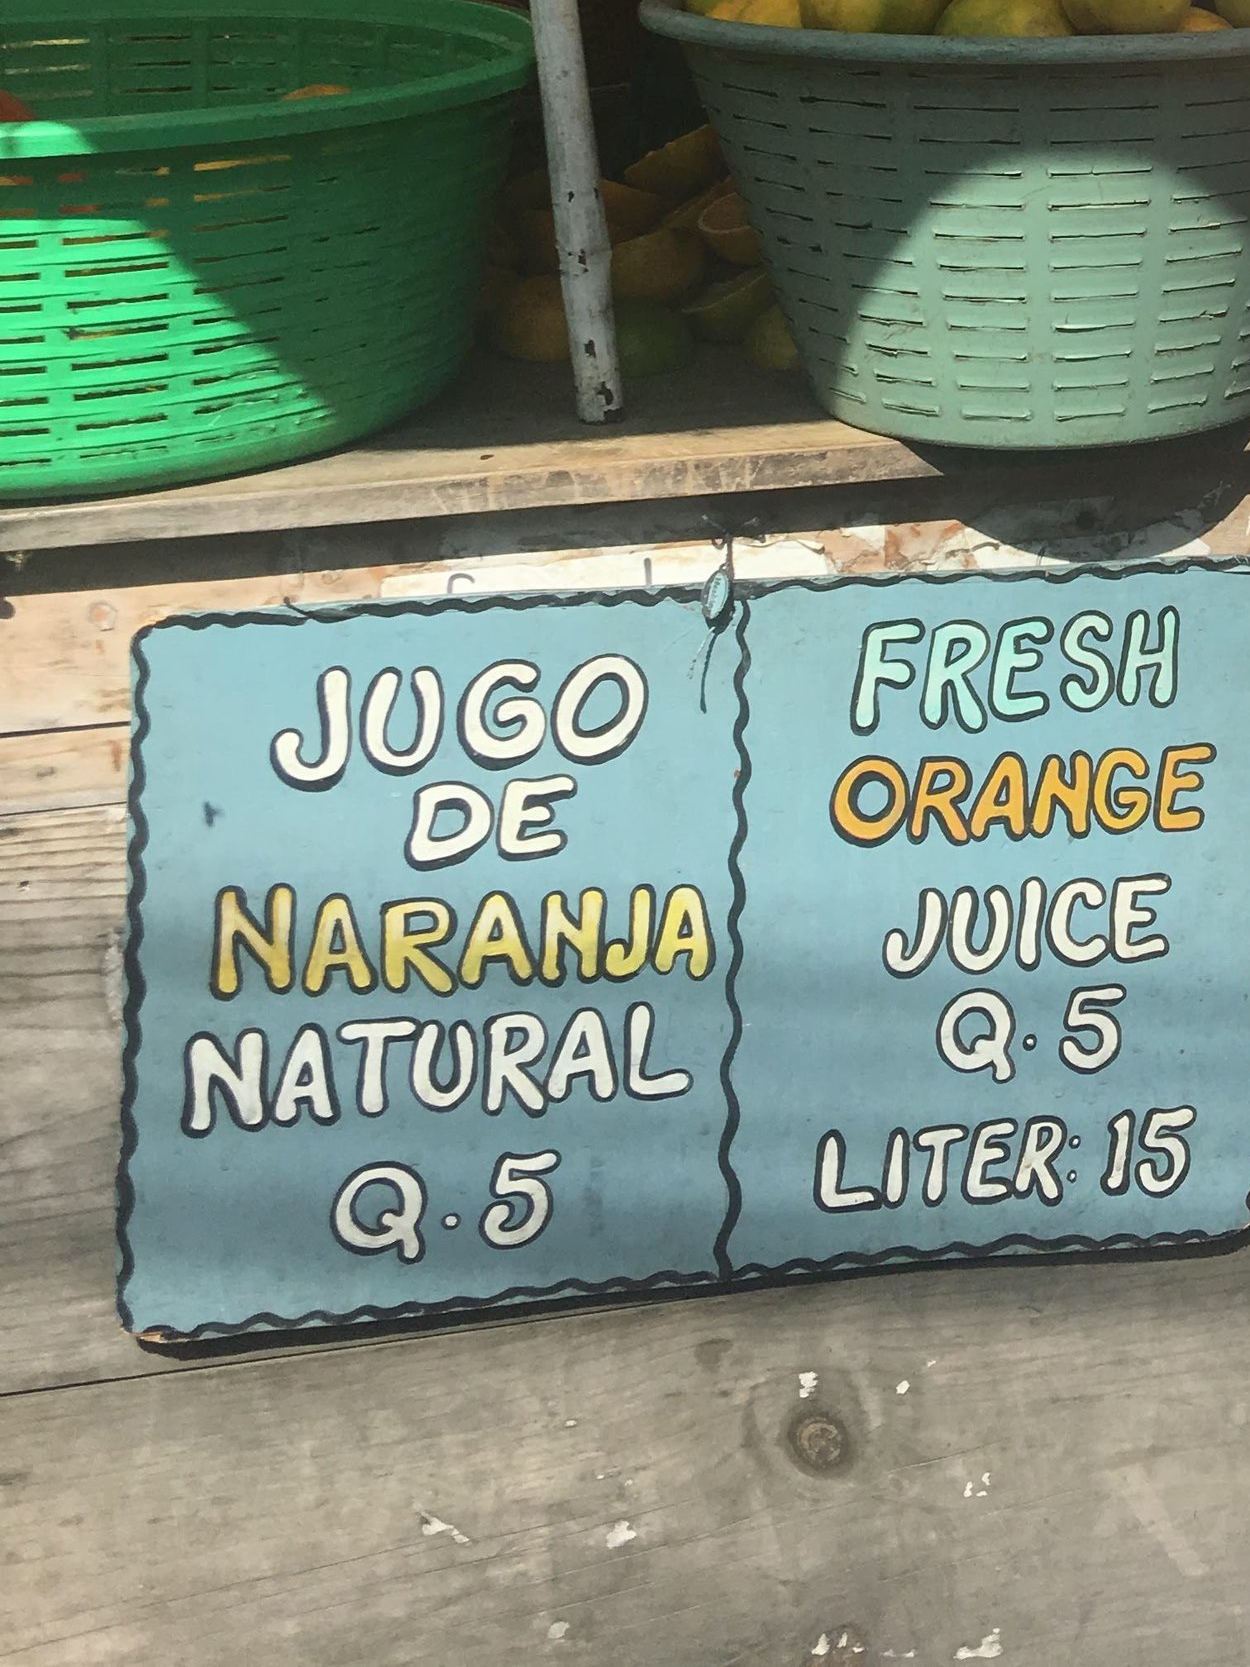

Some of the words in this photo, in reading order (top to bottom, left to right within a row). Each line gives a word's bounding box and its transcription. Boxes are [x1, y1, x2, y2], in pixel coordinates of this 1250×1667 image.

[270, 654, 649, 790] JUGO
[849, 605, 1180, 735] FRESH
[404, 774, 577, 871] DE
[829, 742, 1218, 847] ORANGE
[209, 884, 716, 1001] NARANJA
[881, 873, 1173, 978] JUICE
[181, 1002, 695, 1135] NATURAL
[813, 1118, 1082, 1215] LITER:
[1101, 1105, 1198, 1195] 15
